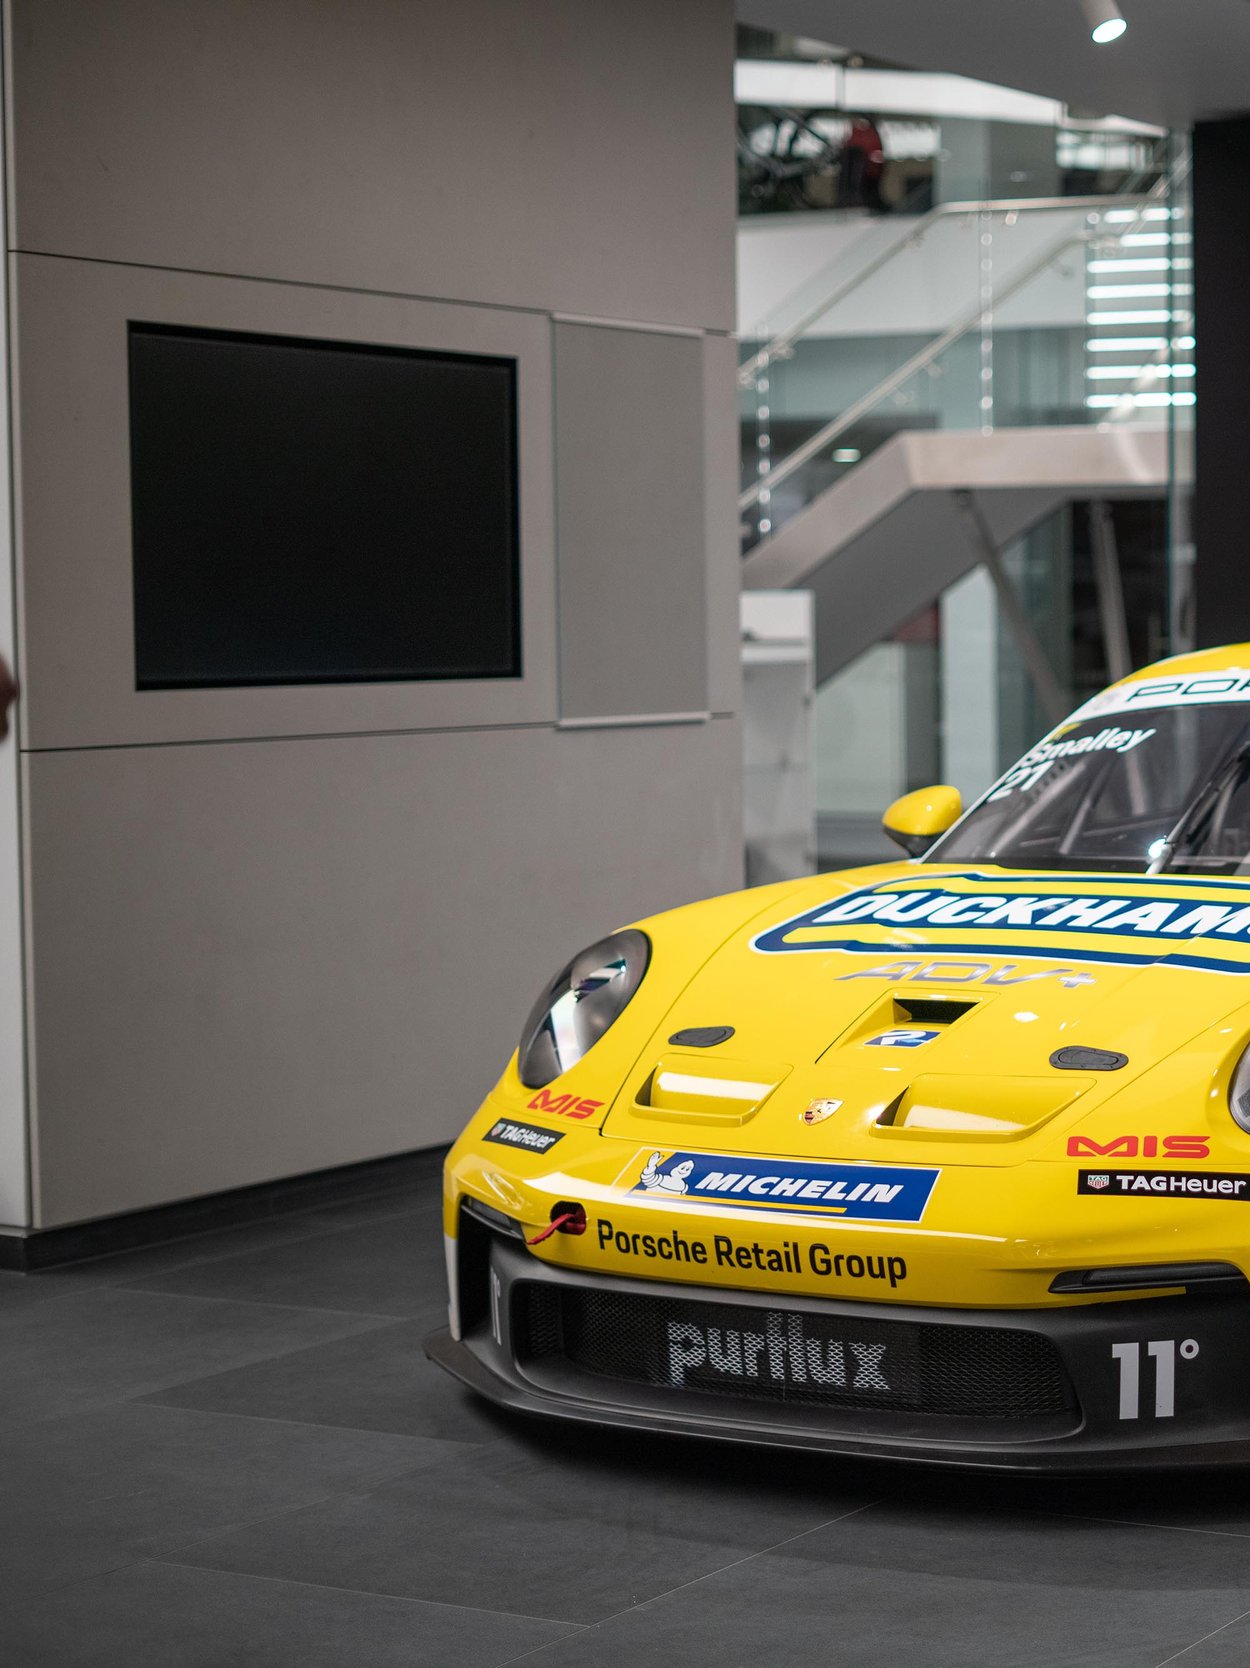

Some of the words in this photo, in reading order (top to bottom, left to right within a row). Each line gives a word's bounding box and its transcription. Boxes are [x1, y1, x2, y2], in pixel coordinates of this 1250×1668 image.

[1021, 727, 1157, 768] Smalley
[527, 1089, 605, 1119] MIS
[1067, 1135, 1211, 1159] MIS
[694, 1172, 904, 1203] MICHELIN
[597, 1218, 708, 1265] Porsche
[714, 1235, 802, 1275] Retail
[809, 1243, 908, 1289] Group
